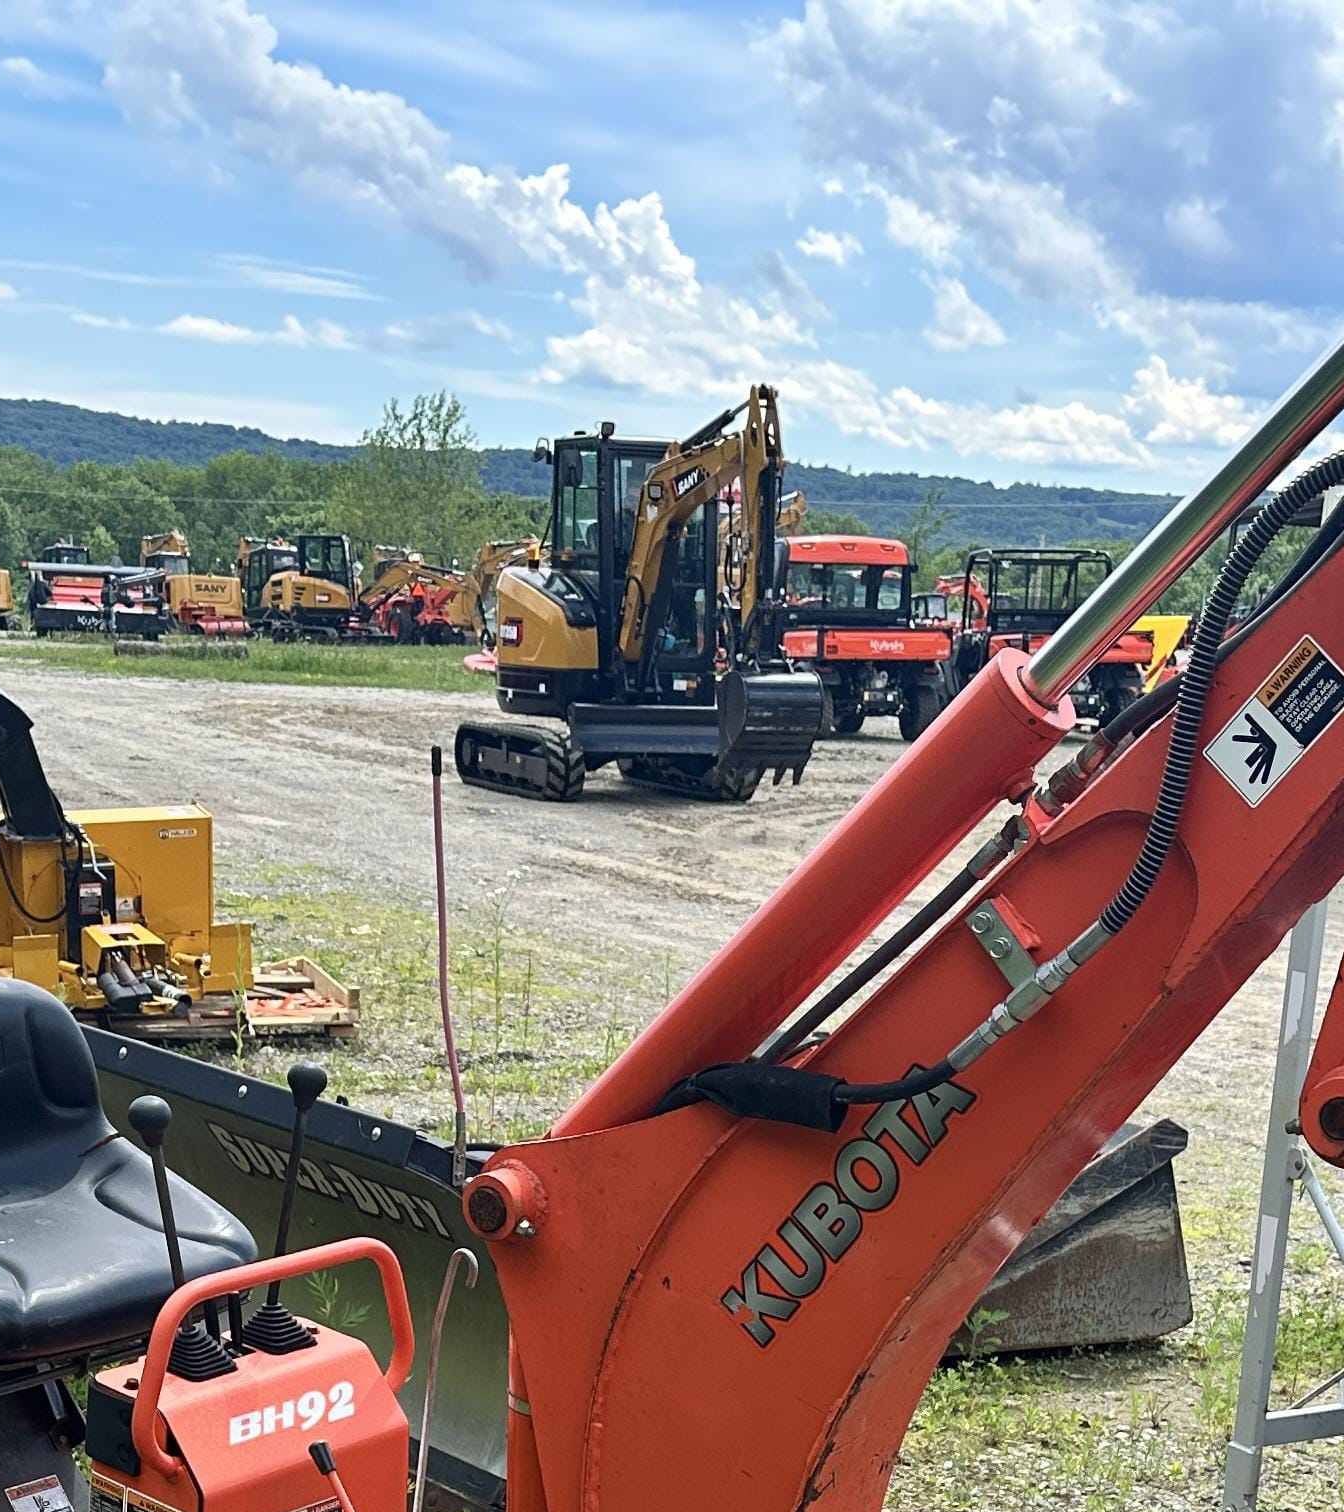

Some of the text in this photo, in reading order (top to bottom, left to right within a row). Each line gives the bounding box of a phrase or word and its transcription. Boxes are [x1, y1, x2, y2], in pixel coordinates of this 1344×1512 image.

[678, 468, 699, 496] SANY
[194, 583, 229, 594] SANY
[869, 639, 905, 651] Kubota
[1269, 645, 1312, 691] WARNING
[1272, 657, 1327, 717] TO AVOID PERSONAL
[1284, 677, 1327, 723] STAY CLEAR OF
[1289, 677, 1336, 728] OPERATING AREA
[720, 1063, 977, 1349] KUBOTA
[229, 1381, 355, 1446] BH92
